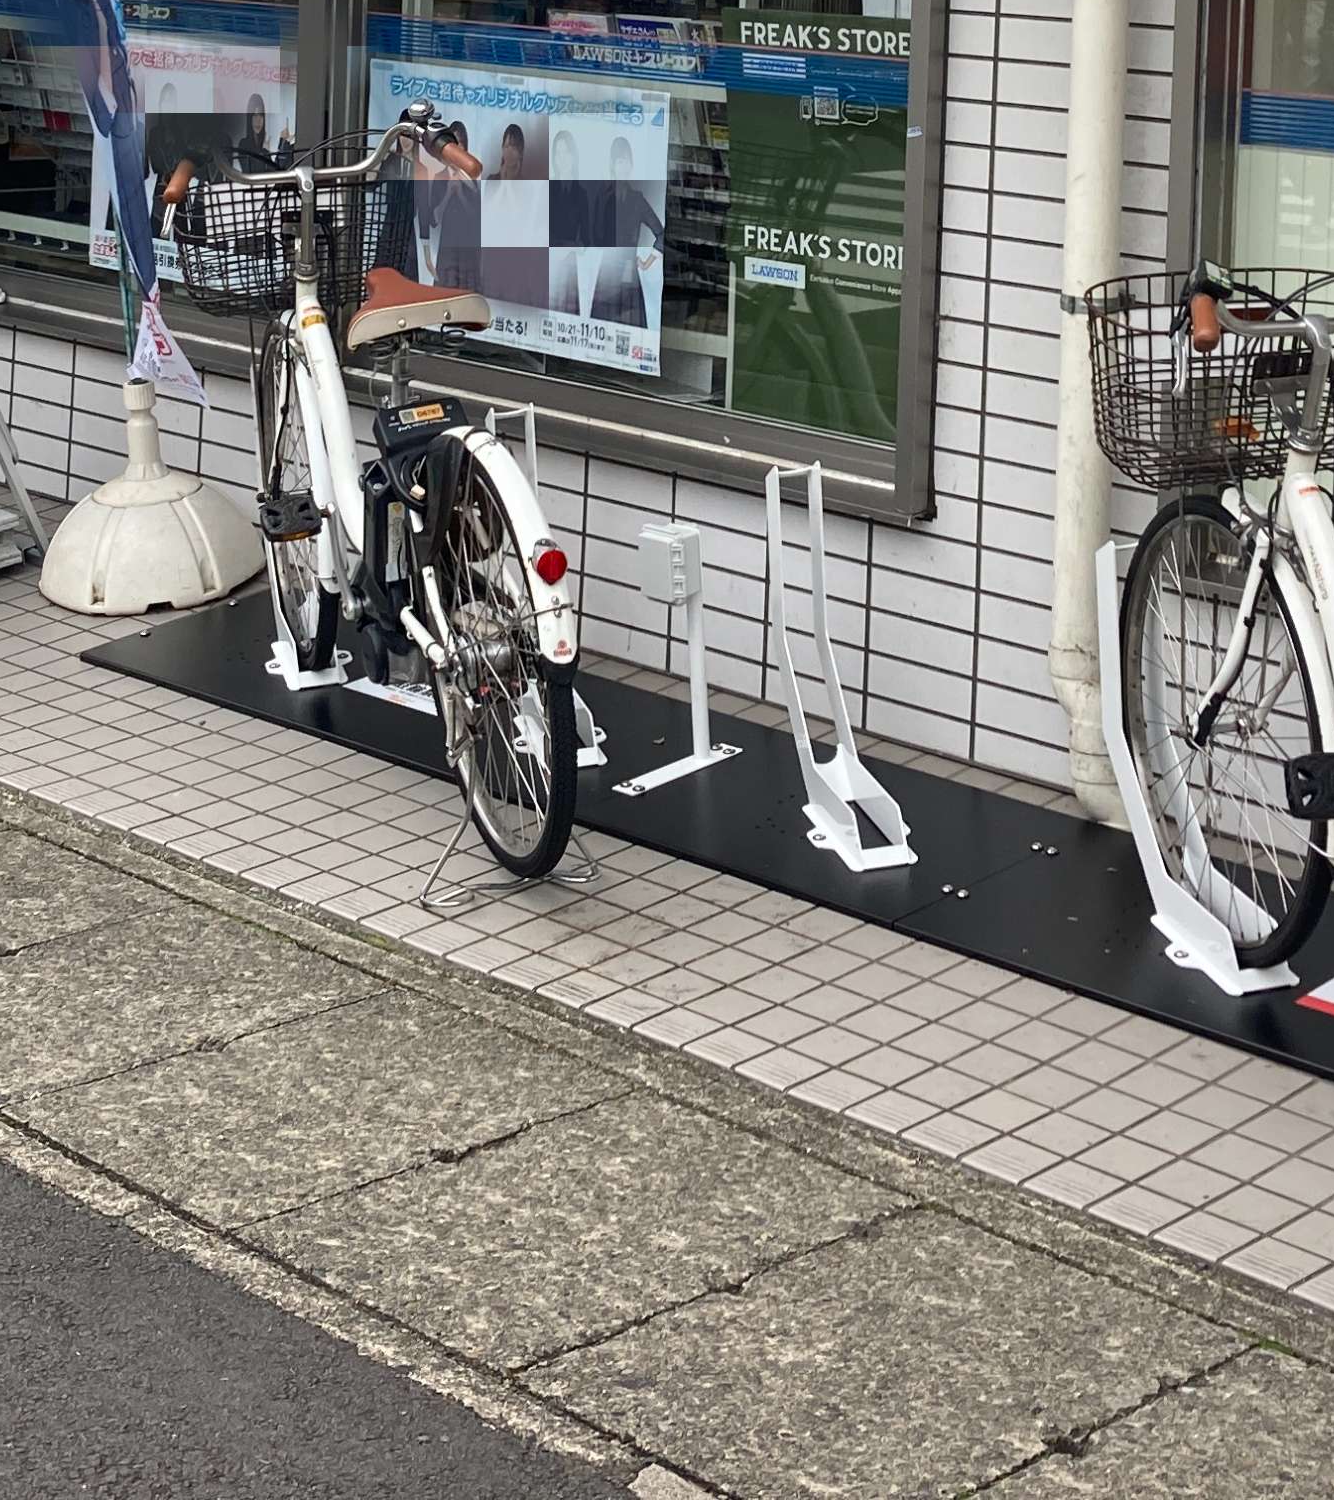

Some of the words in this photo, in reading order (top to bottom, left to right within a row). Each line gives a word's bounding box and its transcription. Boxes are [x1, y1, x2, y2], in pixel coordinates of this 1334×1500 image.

[740, 21, 831, 51] FREAK'S
[836, 27, 911, 56] STORE
[744, 224, 832, 260] FREAK'S
[751, 263, 799, 282] LAWSON
[490, 316, 529, 337] 当たる!
